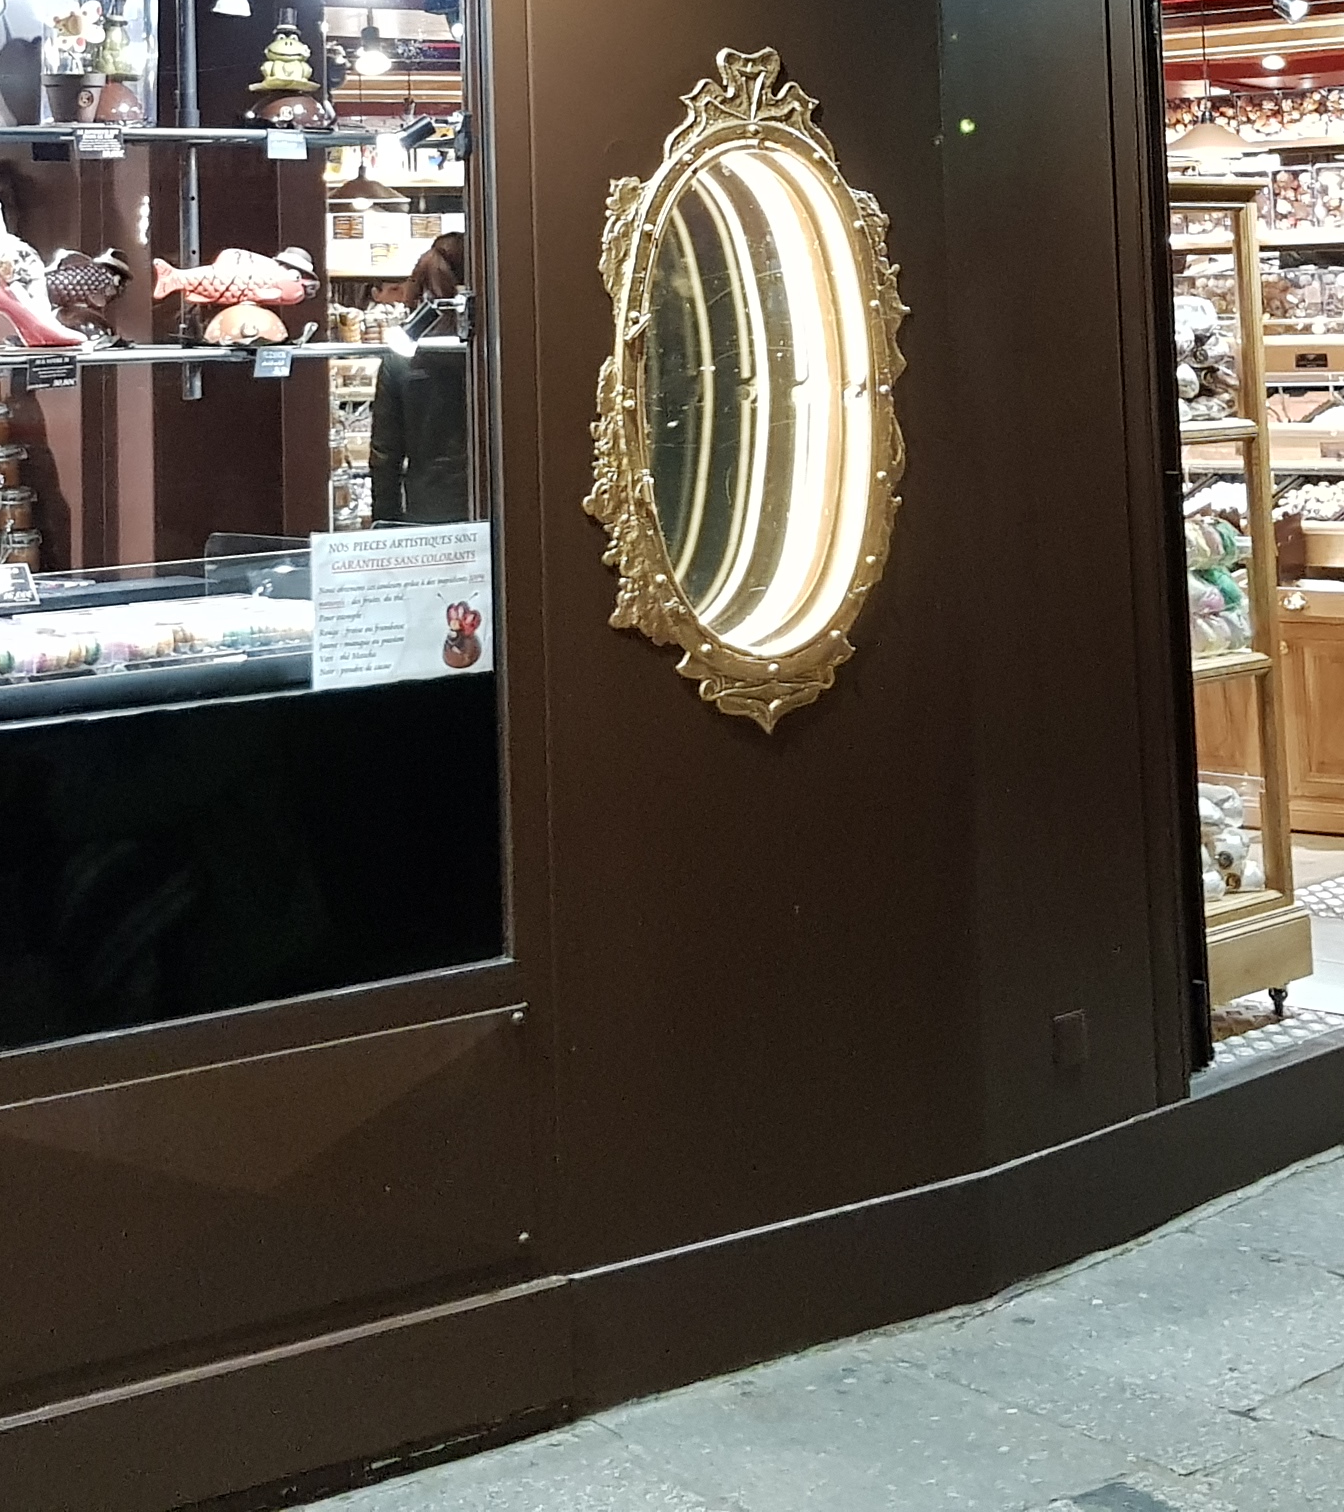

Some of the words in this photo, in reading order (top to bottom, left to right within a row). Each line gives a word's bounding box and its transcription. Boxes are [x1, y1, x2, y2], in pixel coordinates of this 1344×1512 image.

[329, 543, 349, 553] NOS
[353, 539, 387, 551] PIECES
[389, 535, 453, 549] ARTISTIQUES
[454, 533, 478, 543] SONT
[331, 557, 392, 571] GARANTIES
[393, 554, 419, 566] SANS
[421, 550, 476, 564] COLORANTS
